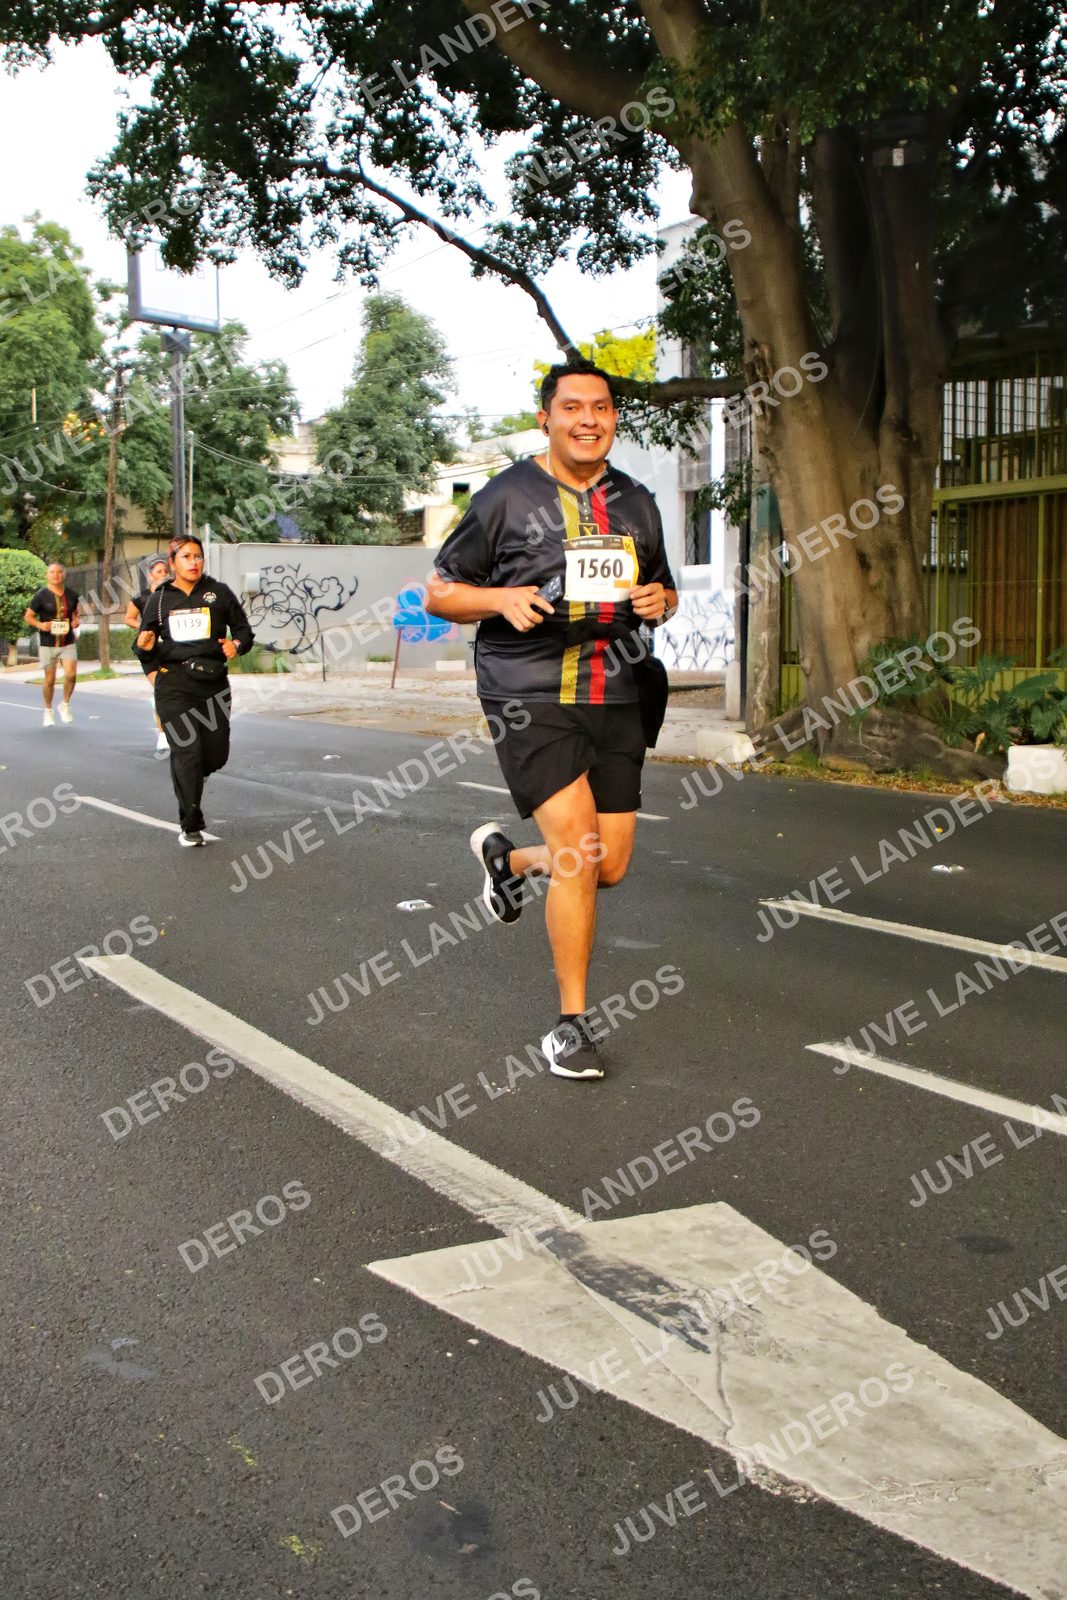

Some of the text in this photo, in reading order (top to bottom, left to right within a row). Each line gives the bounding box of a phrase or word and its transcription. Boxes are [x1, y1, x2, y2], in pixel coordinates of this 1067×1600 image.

[261, 563, 301, 578] TOY
[577, 558, 624, 579] 1560
[177, 618, 202, 629] 1139
